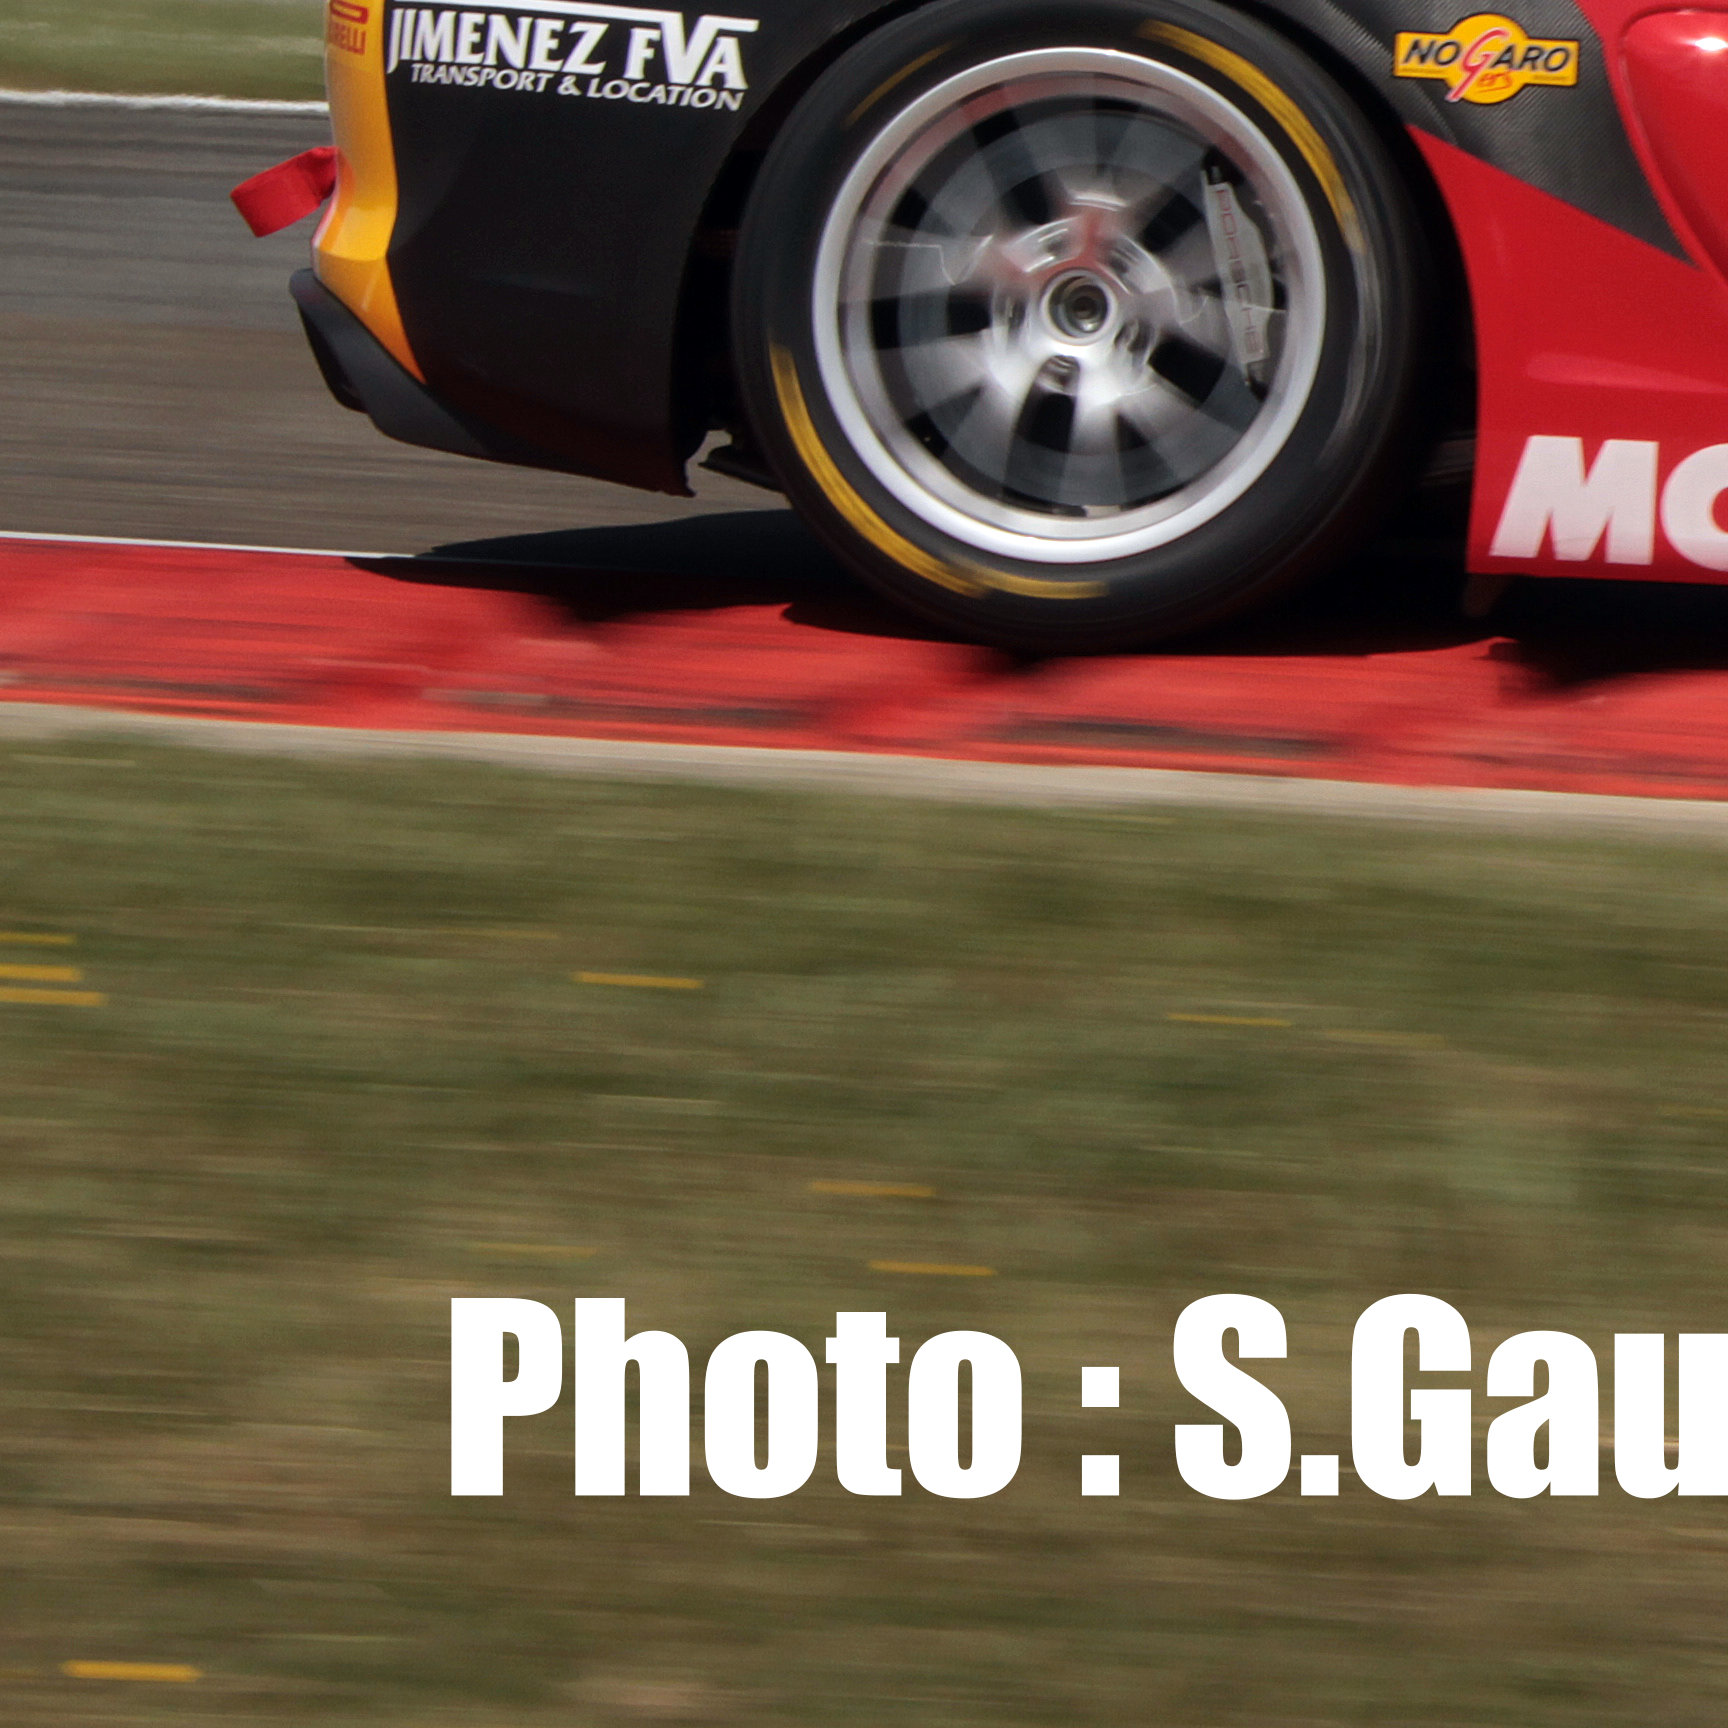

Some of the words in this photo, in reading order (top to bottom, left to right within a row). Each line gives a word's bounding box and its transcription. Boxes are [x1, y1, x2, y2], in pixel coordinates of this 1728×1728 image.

[387, 8, 610, 74] JIMENEZ
[411, 63, 554, 94] TRANSPORT
[557, 77, 583, 96] &
[587, 81, 745, 112] LOCATION
